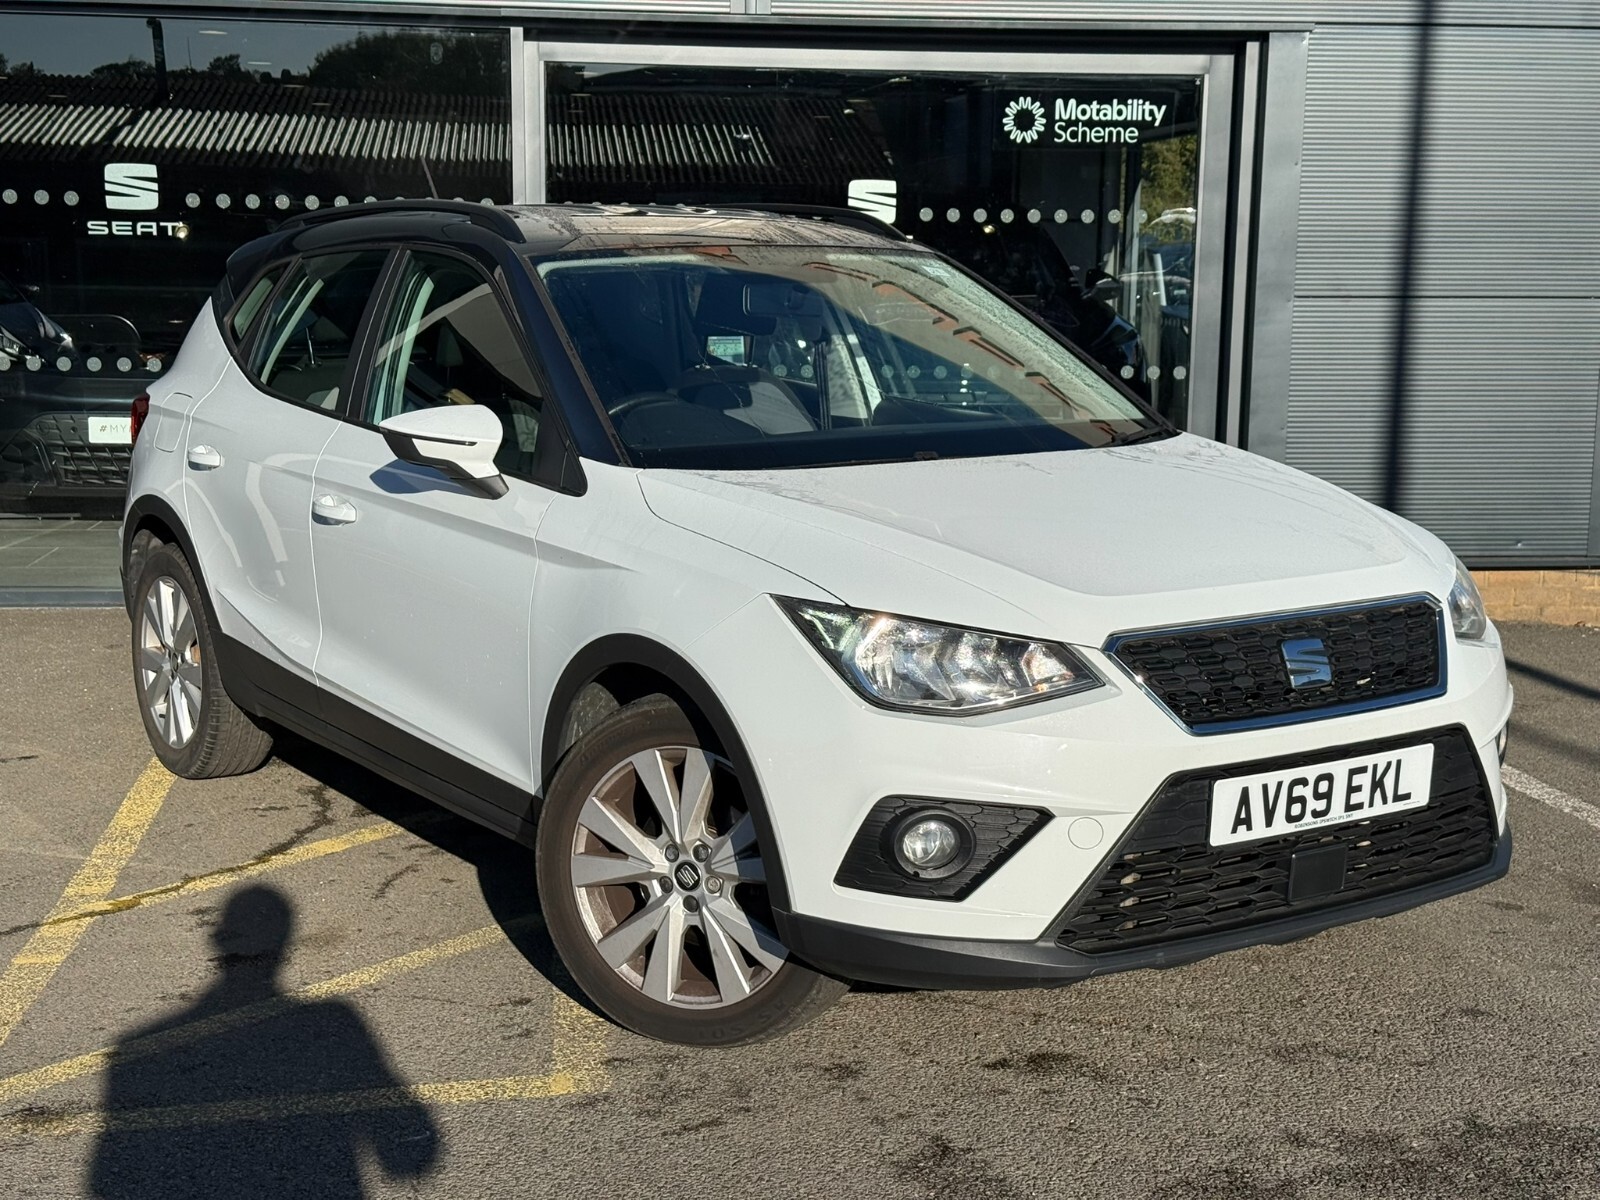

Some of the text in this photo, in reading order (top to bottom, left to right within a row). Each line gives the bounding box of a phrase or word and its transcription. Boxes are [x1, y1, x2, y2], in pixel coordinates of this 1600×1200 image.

[1054, 98, 1167, 127] Motability
[1053, 121, 1139, 143] Scheme
[86, 220, 183, 236] SEAT
[1230, 758, 1412, 834] AV69 EKL
